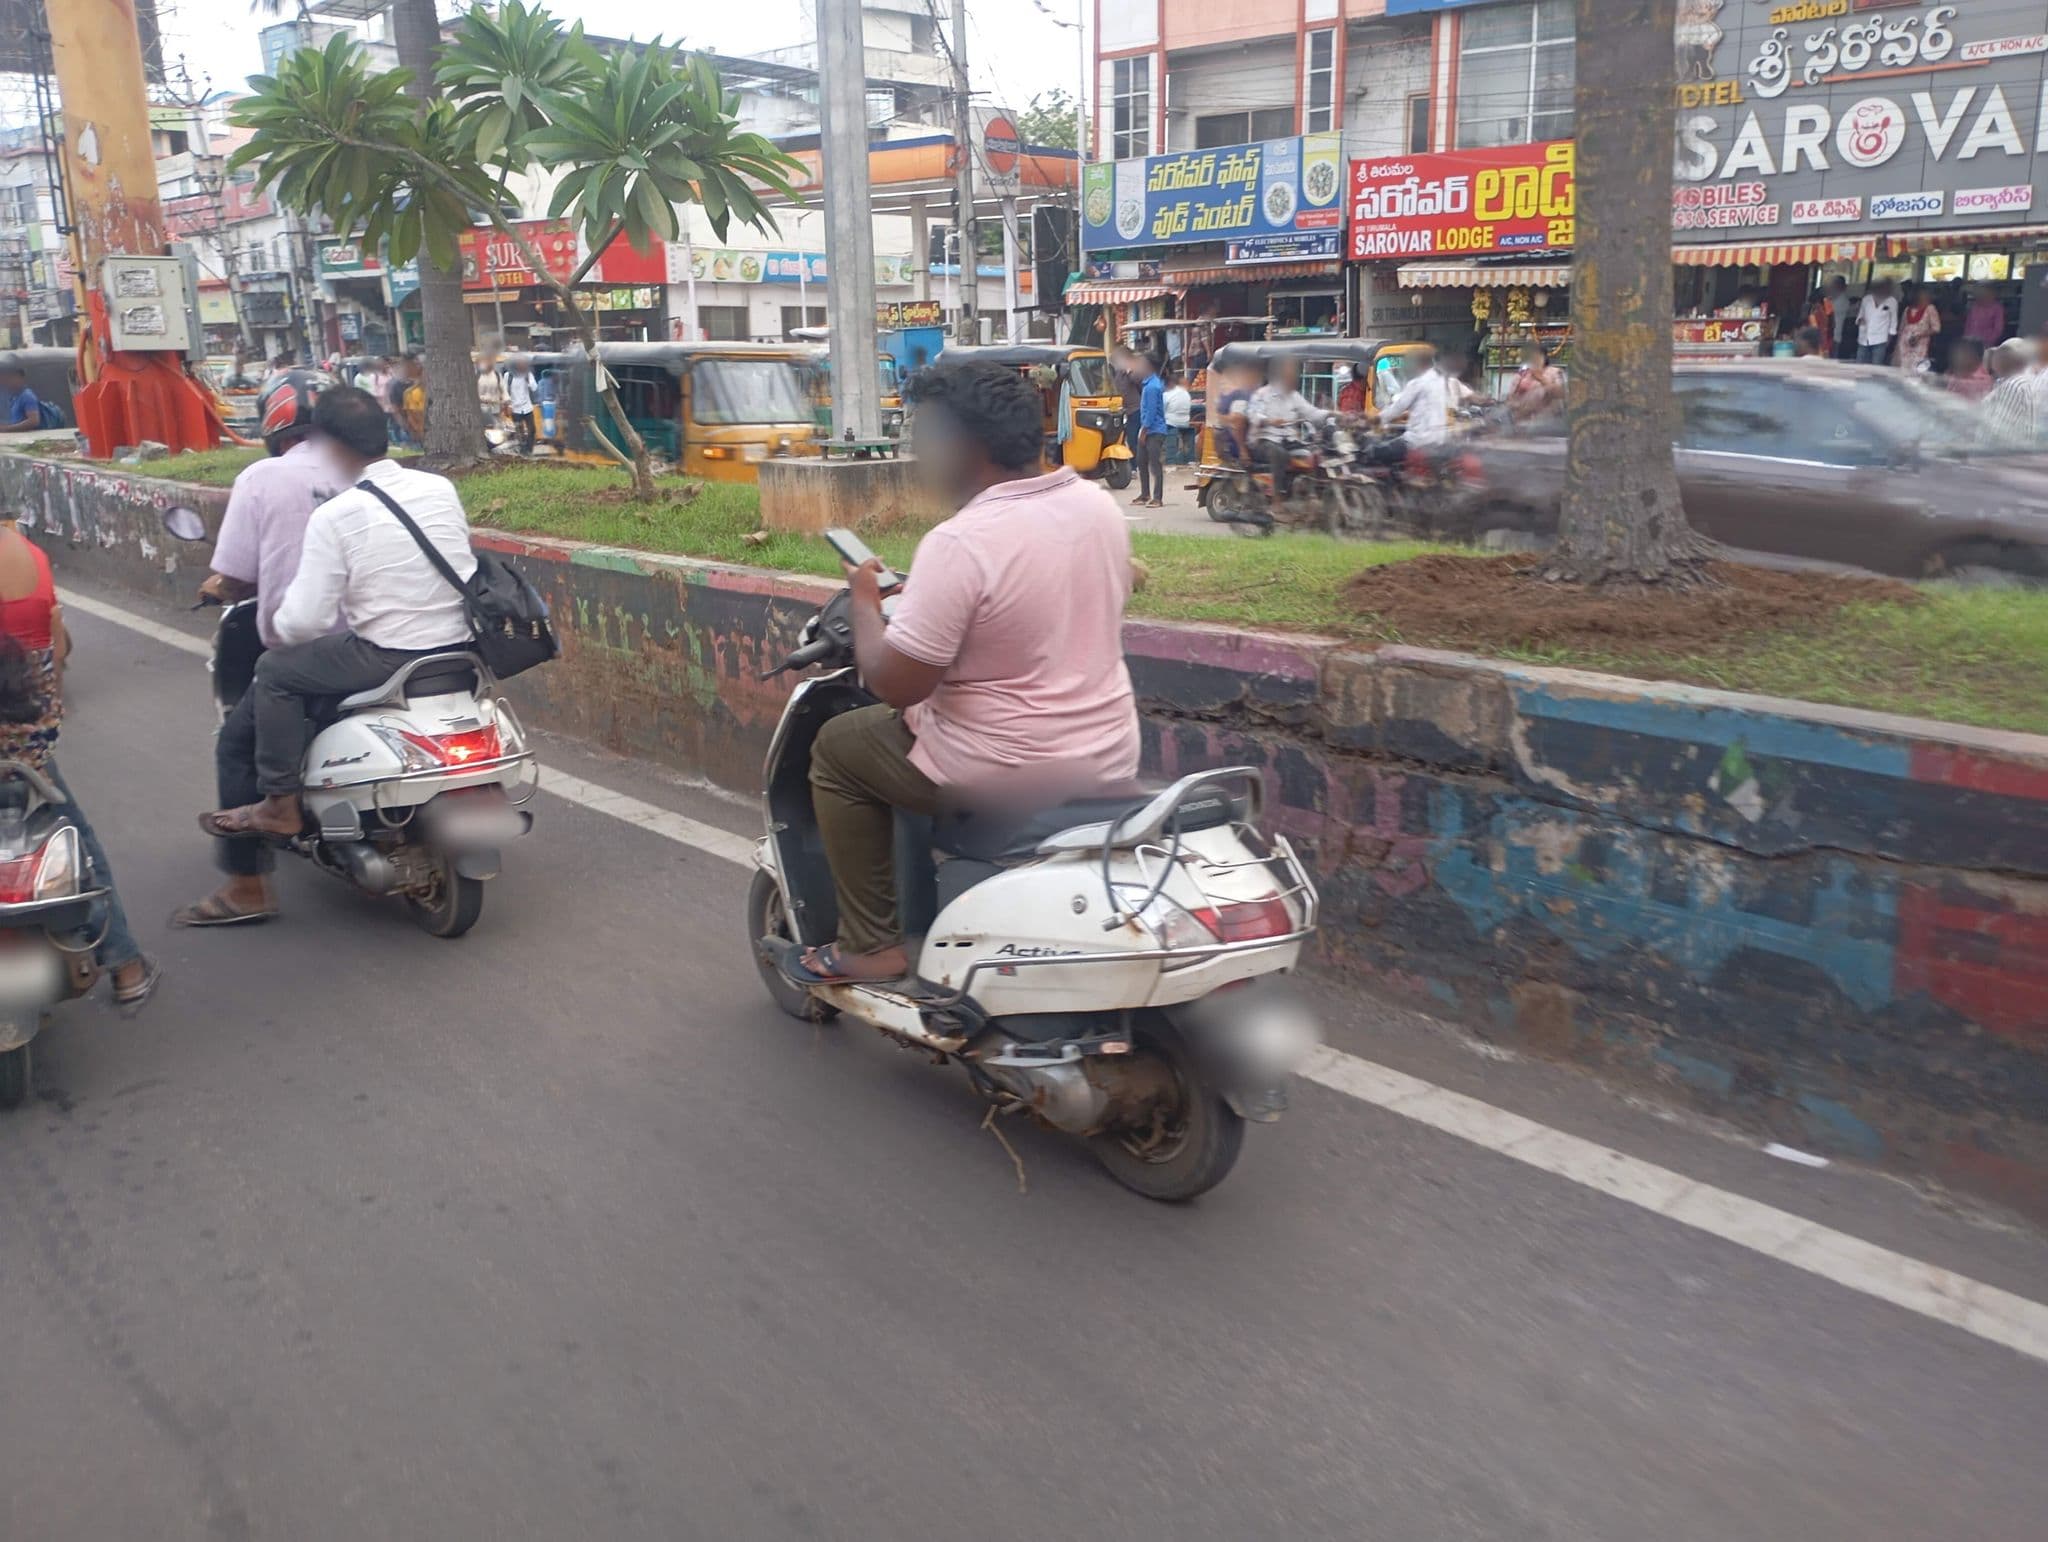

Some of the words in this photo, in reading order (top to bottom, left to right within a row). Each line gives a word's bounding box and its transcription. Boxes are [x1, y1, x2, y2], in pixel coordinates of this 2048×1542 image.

[1803, 6, 1957, 85] సరోవర్
[1675, 79, 2048, 181] SAROVA
[1147, 154, 1217, 193] సరోవర్
[1356, 163, 1369, 183] శ్రీ
[1370, 163, 1414, 178] తిరుమల
[1355, 175, 1469, 220] సరోవర్
[1872, 196, 1941, 217] భోజనం
[1355, 230, 1432, 255] SAROVAR
[1437, 226, 1494, 251] LODGE
